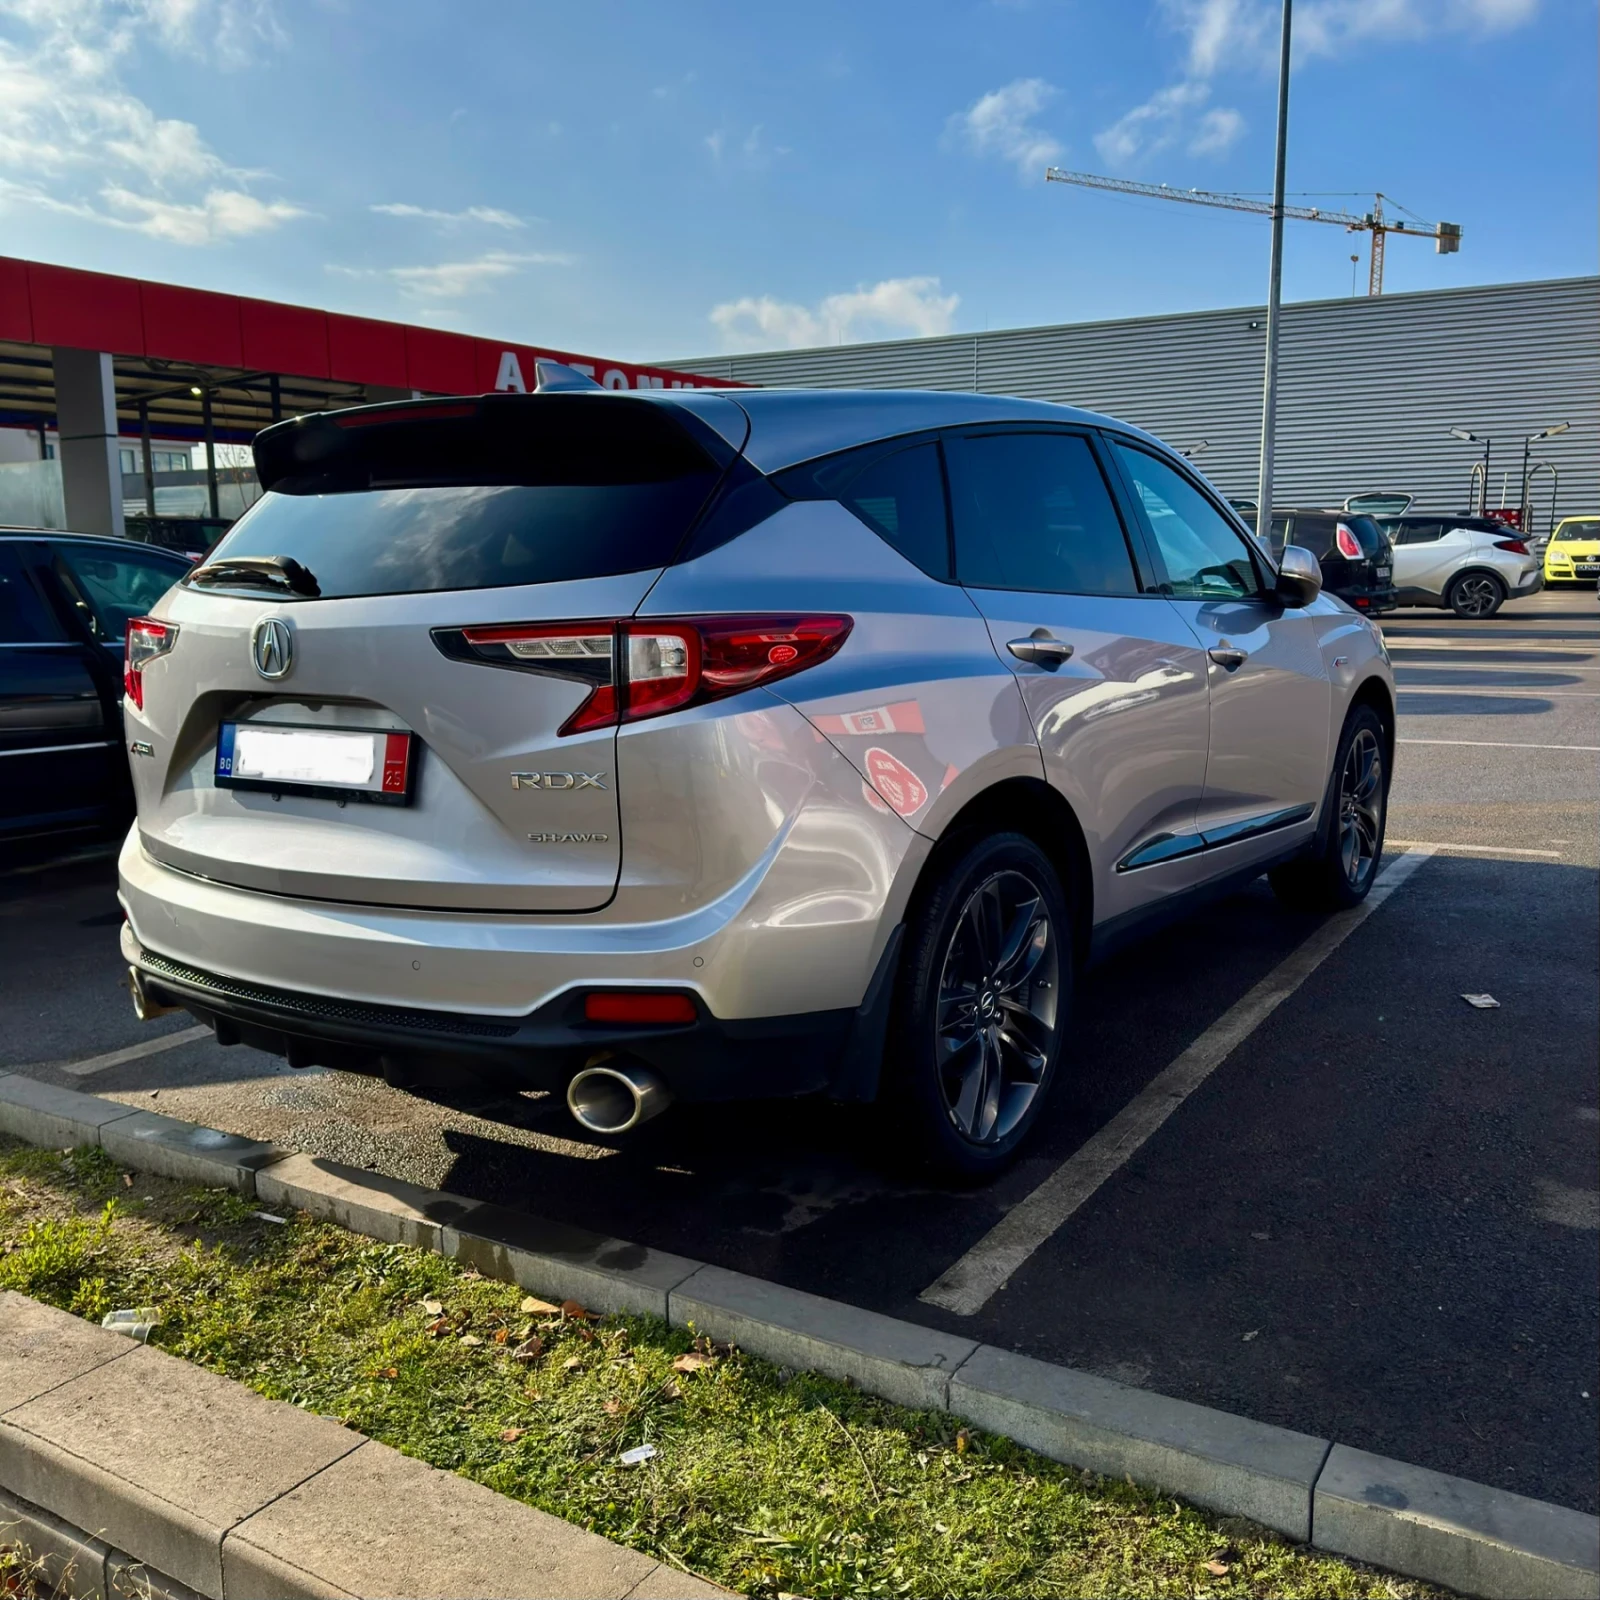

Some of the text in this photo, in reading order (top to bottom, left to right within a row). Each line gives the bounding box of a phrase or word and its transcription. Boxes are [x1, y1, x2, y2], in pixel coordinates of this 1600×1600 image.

[219, 757, 232, 770] BG
[385, 770, 402, 786] 25
[510, 771, 608, 790] RDX
